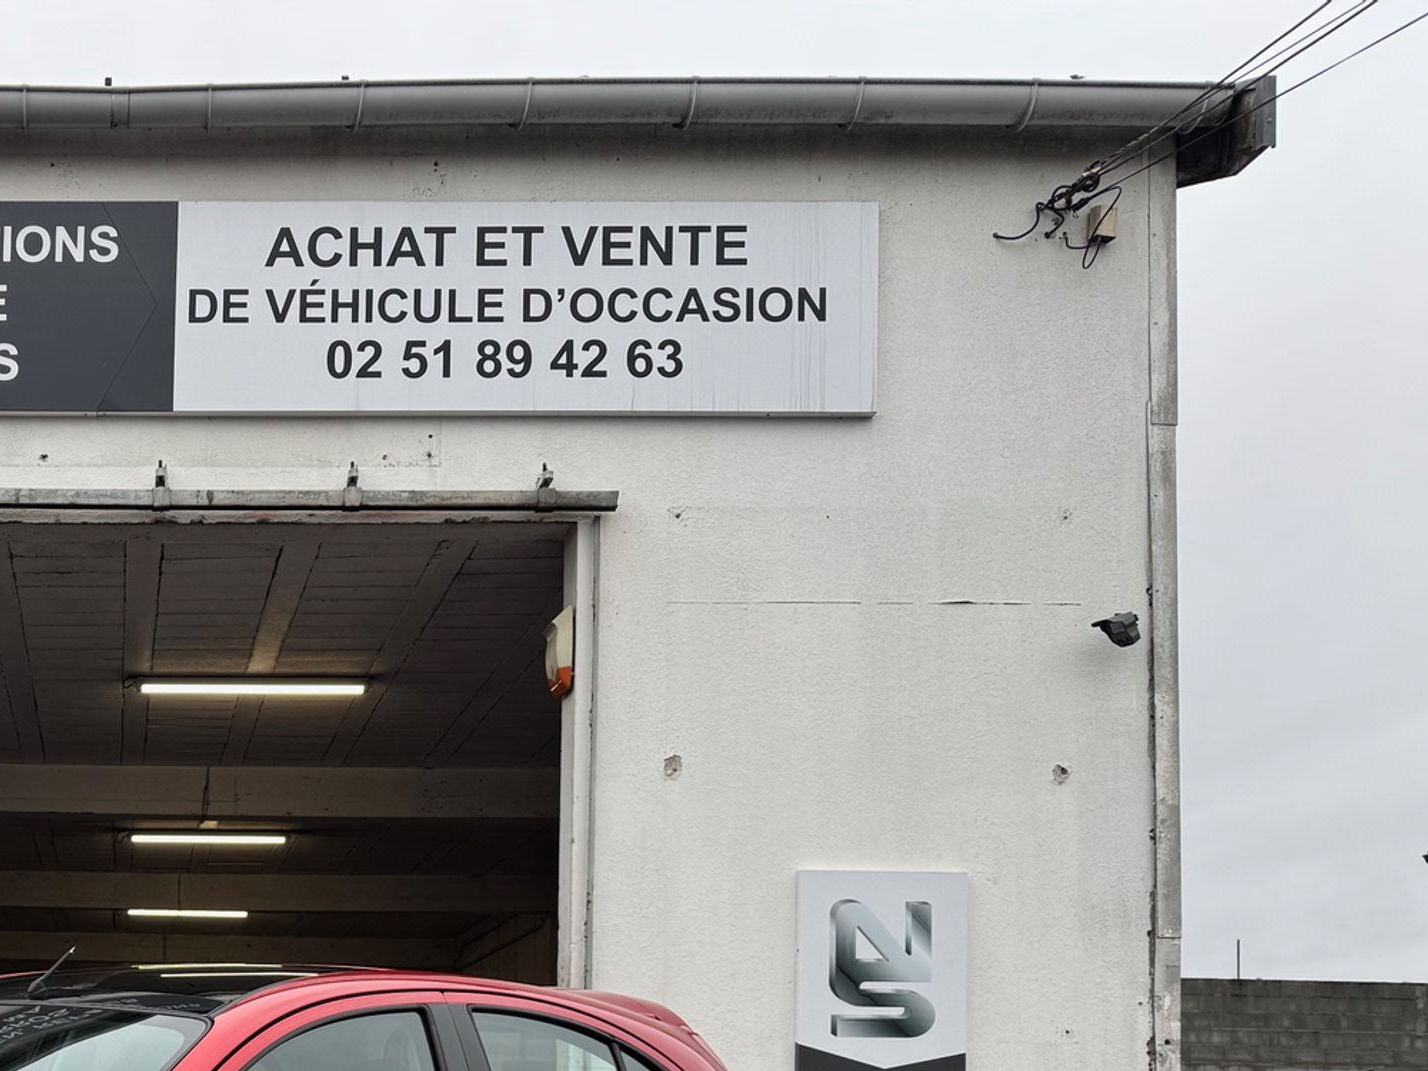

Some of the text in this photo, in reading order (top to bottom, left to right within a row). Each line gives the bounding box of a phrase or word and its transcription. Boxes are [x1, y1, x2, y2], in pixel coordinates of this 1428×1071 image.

[265, 225, 748, 268] ACHAT ET VENTE
[188, 288, 250, 324] DE
[265, 278, 505, 324] VÉHICULE
[326, 338, 684, 379] 02 51 89 42 63
